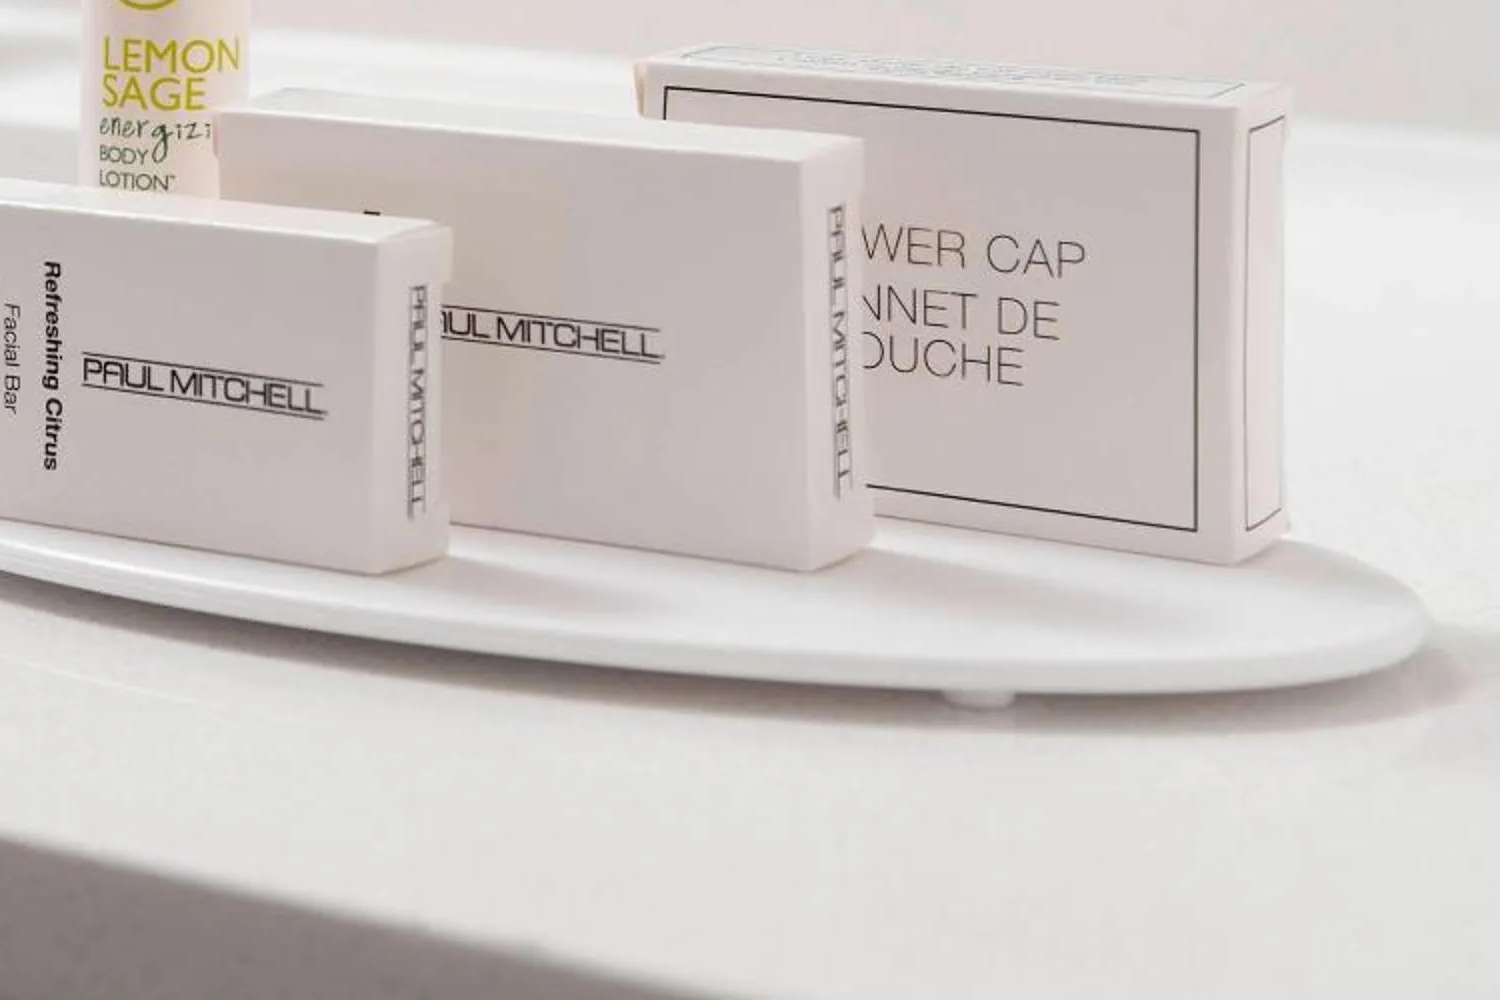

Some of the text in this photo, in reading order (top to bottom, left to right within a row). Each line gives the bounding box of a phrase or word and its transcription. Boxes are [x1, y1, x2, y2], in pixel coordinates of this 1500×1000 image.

[103, 36, 239, 73] LEMON
[102, 74, 206, 111] SAGE
[99, 145, 148, 165] BODY
[100, 116, 211, 163] energizi
[862, 223, 1085, 278] WER CAP
[497, 316, 663, 359] MITCHELL
[862, 284, 1060, 340] NNET DE
[4, 303, 20, 415] Facial Bar
[42, 261, 63, 471] Refreshing Citrus
[83, 358, 325, 414] PAUL MITCHELL
[862, 331, 1024, 386] OUCHE
